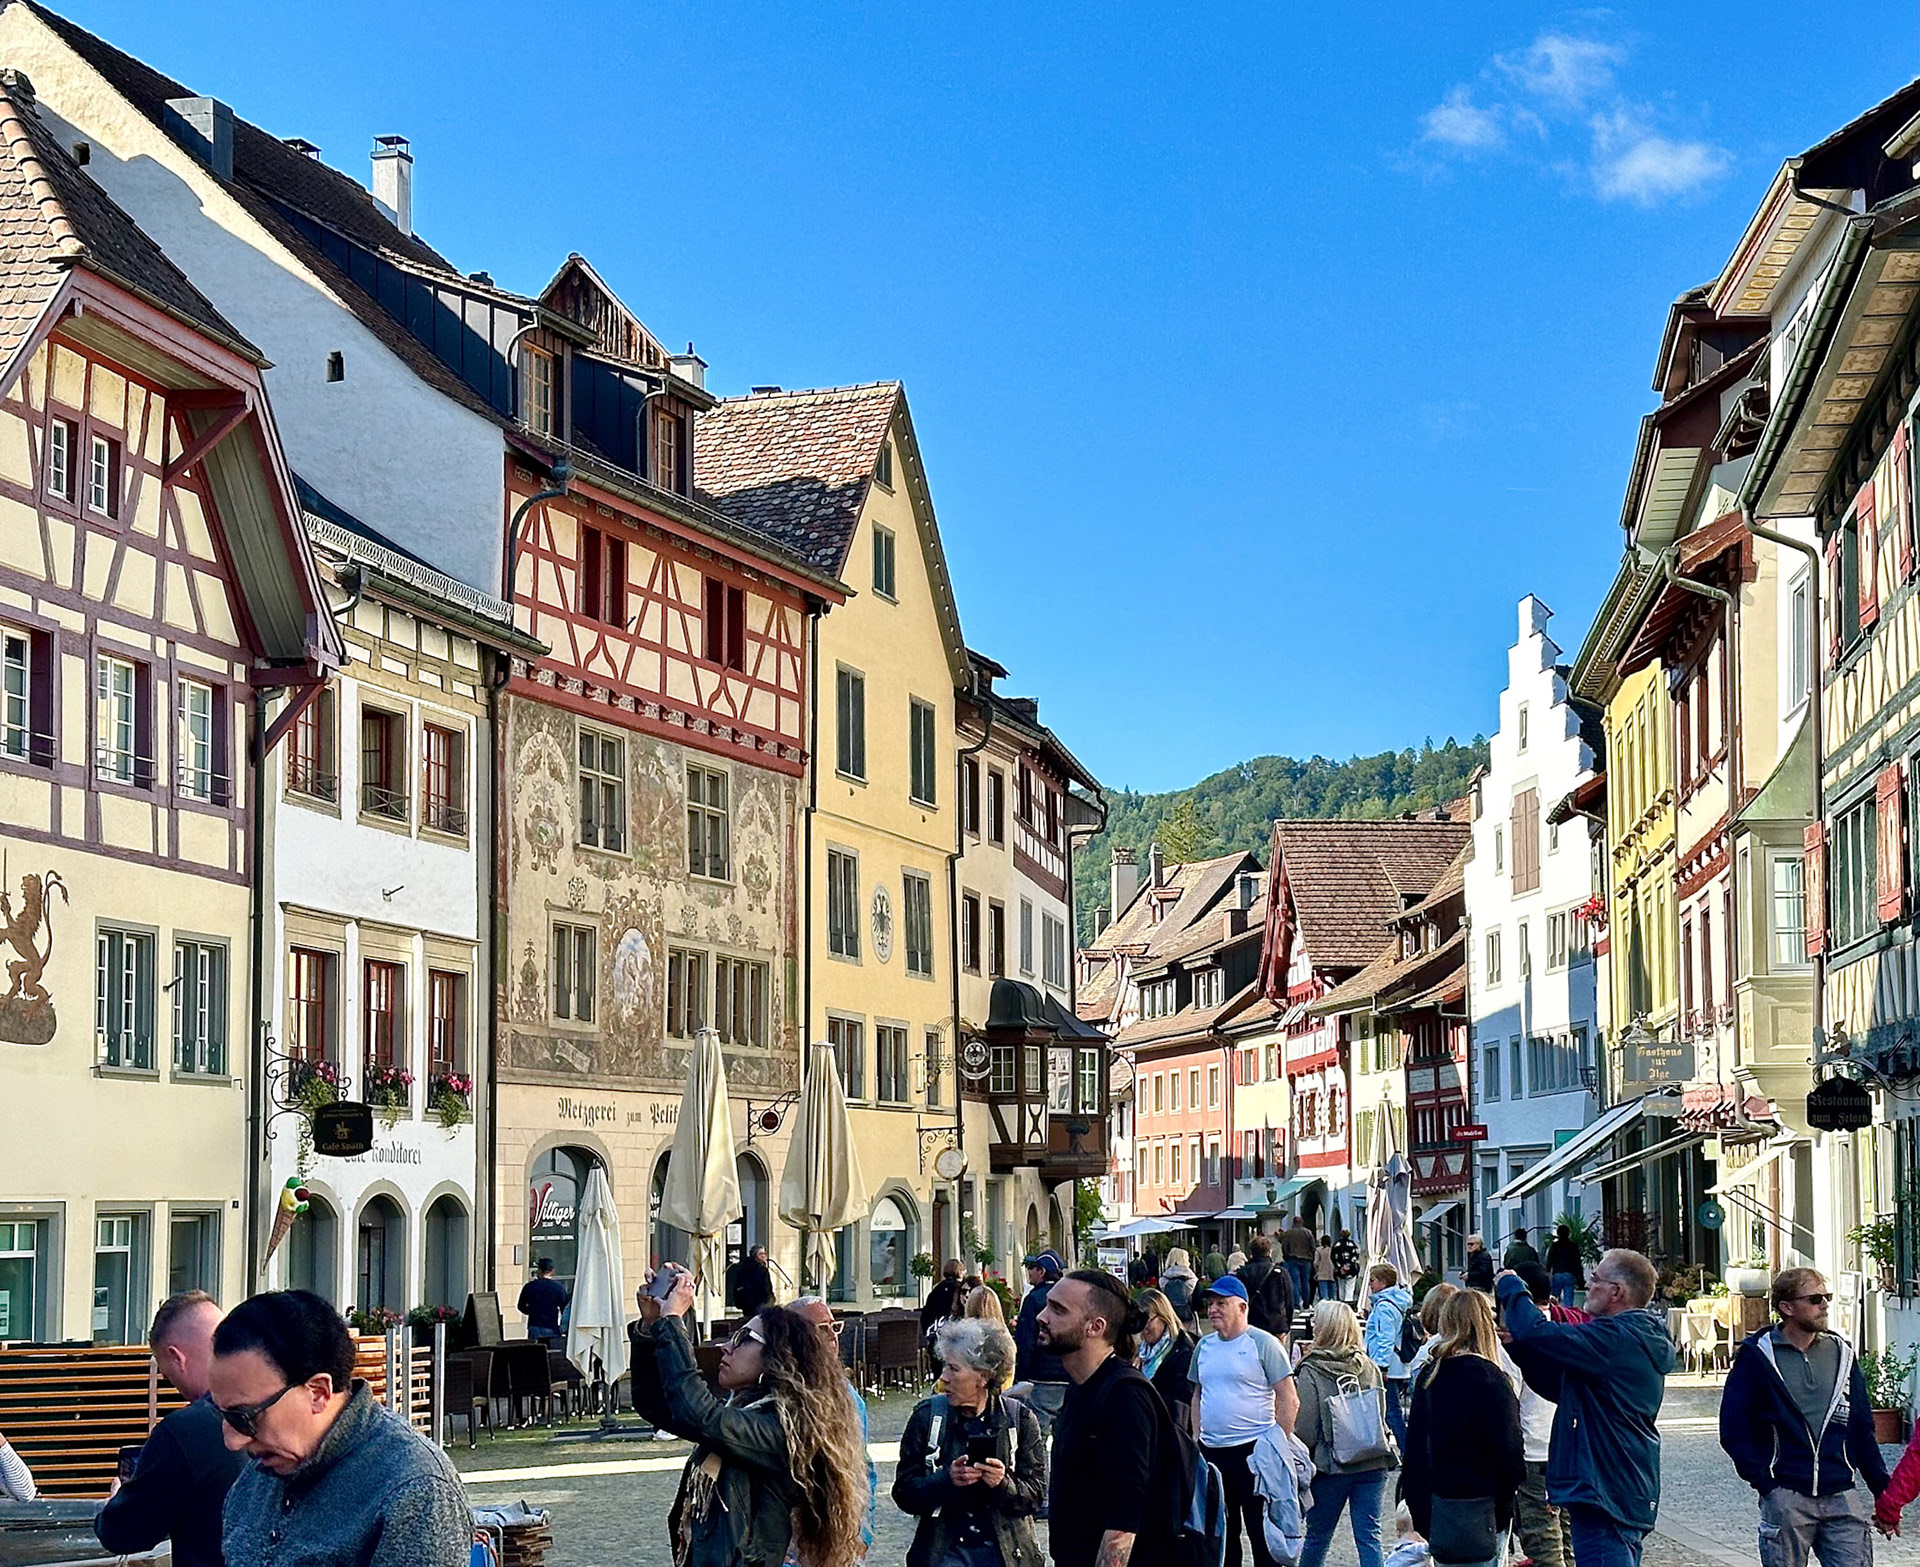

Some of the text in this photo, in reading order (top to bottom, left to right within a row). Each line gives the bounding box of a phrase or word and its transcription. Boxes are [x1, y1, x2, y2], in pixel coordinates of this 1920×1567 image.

[1636, 1046, 1682, 1057] Gasthaus
[1809, 1094, 1870, 1106] Restaurant
[558, 1097, 679, 1129] Metzgerei zum Pelik
[1811, 1114, 1831, 1125] zum
[371, 1140, 422, 1164] Konditorei
[530, 1182, 576, 1229] Villiger
